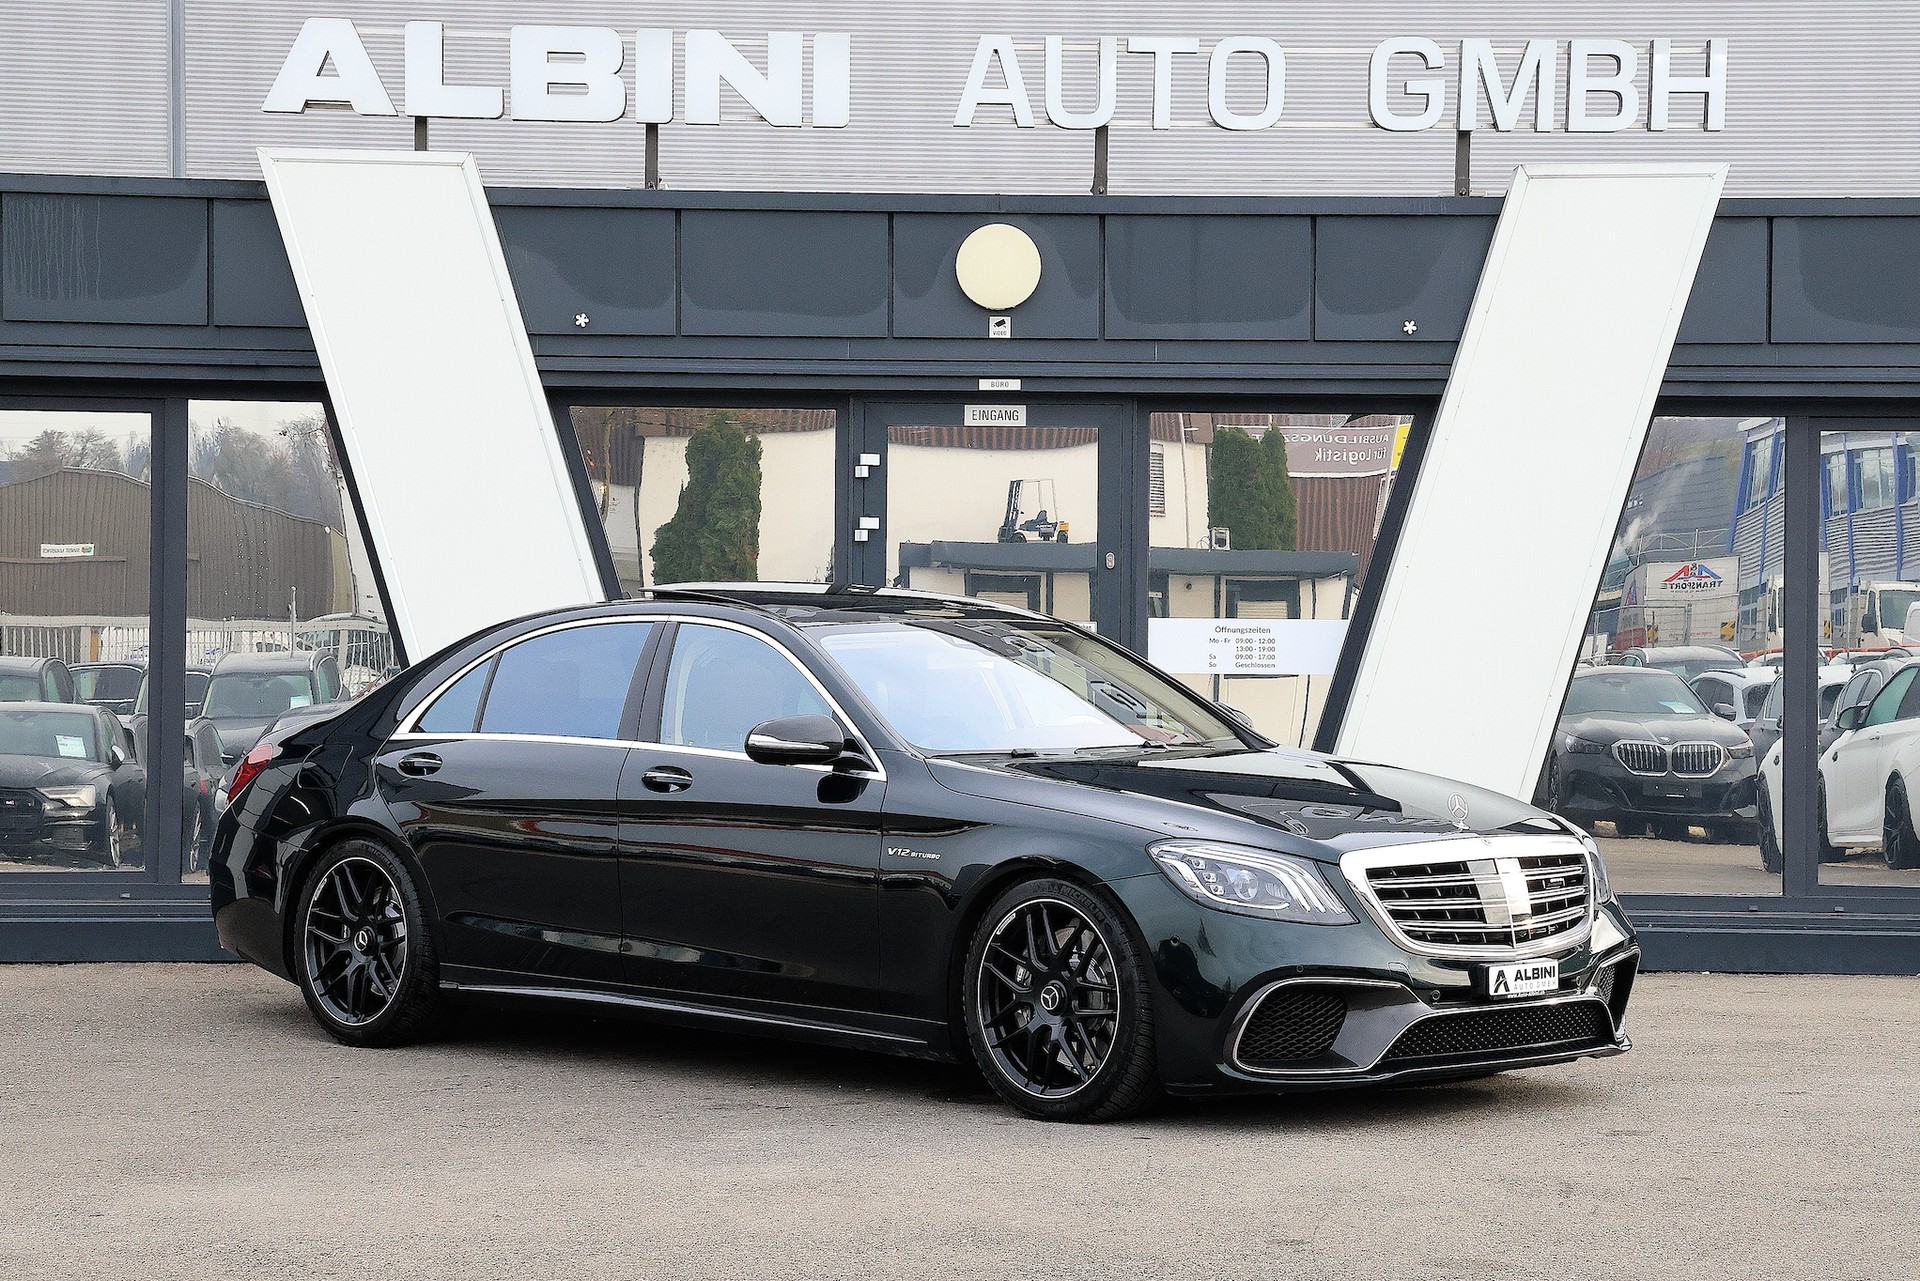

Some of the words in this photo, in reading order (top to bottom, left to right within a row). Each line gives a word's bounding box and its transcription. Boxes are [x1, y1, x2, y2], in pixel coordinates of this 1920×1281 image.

[260, 17, 851, 128] ALBINI
[952, 34, 1287, 131] AUTO
[1369, 36, 1728, 133] GMBH
[990, 380, 1010, 388] BÜRO
[972, 409, 1019, 421] EINGANG
[1214, 625, 1271, 634] Öffnungszeiten
[888, 847, 910, 857] V12
[910, 851, 941, 860] BITURBO
[1060, 885, 1107, 923] MICHELIN
[1514, 965, 1556, 982] ALBINI
[1513, 982, 1534, 991] AUTO
[1536, 979, 1557, 989] GMBH
